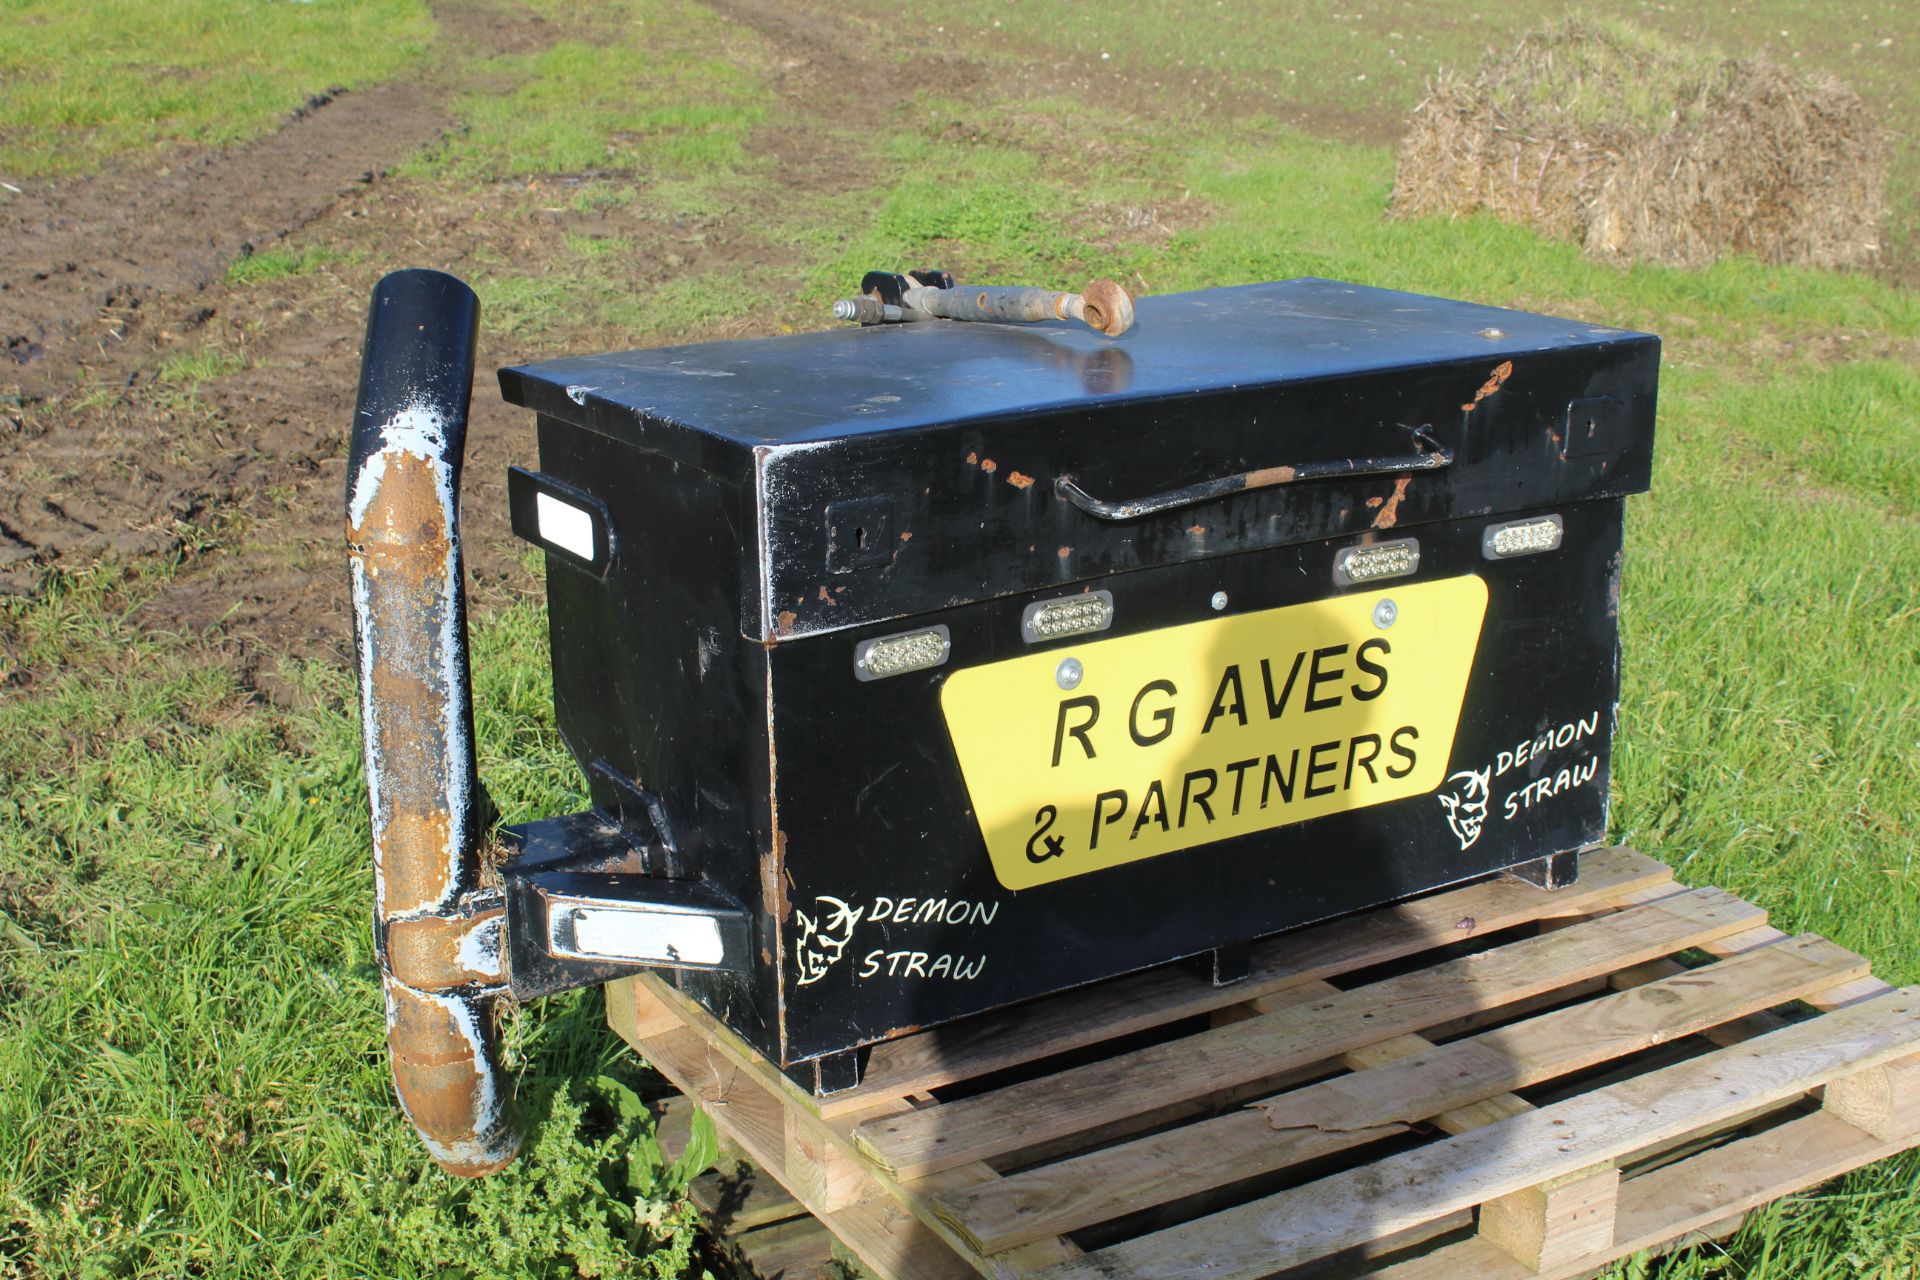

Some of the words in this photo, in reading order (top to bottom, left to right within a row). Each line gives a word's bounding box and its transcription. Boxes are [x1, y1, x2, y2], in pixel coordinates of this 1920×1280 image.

[1051, 694, 1100, 768] R
[1127, 679, 1177, 747] G
[1201, 637, 1391, 733] AVES
[1025, 804, 1064, 864] &
[1088, 725, 1420, 850] PARTNERS
[1504, 755, 1598, 820] STRAW
[867, 896, 999, 925] DEMON
[859, 949, 986, 980] STRAW
